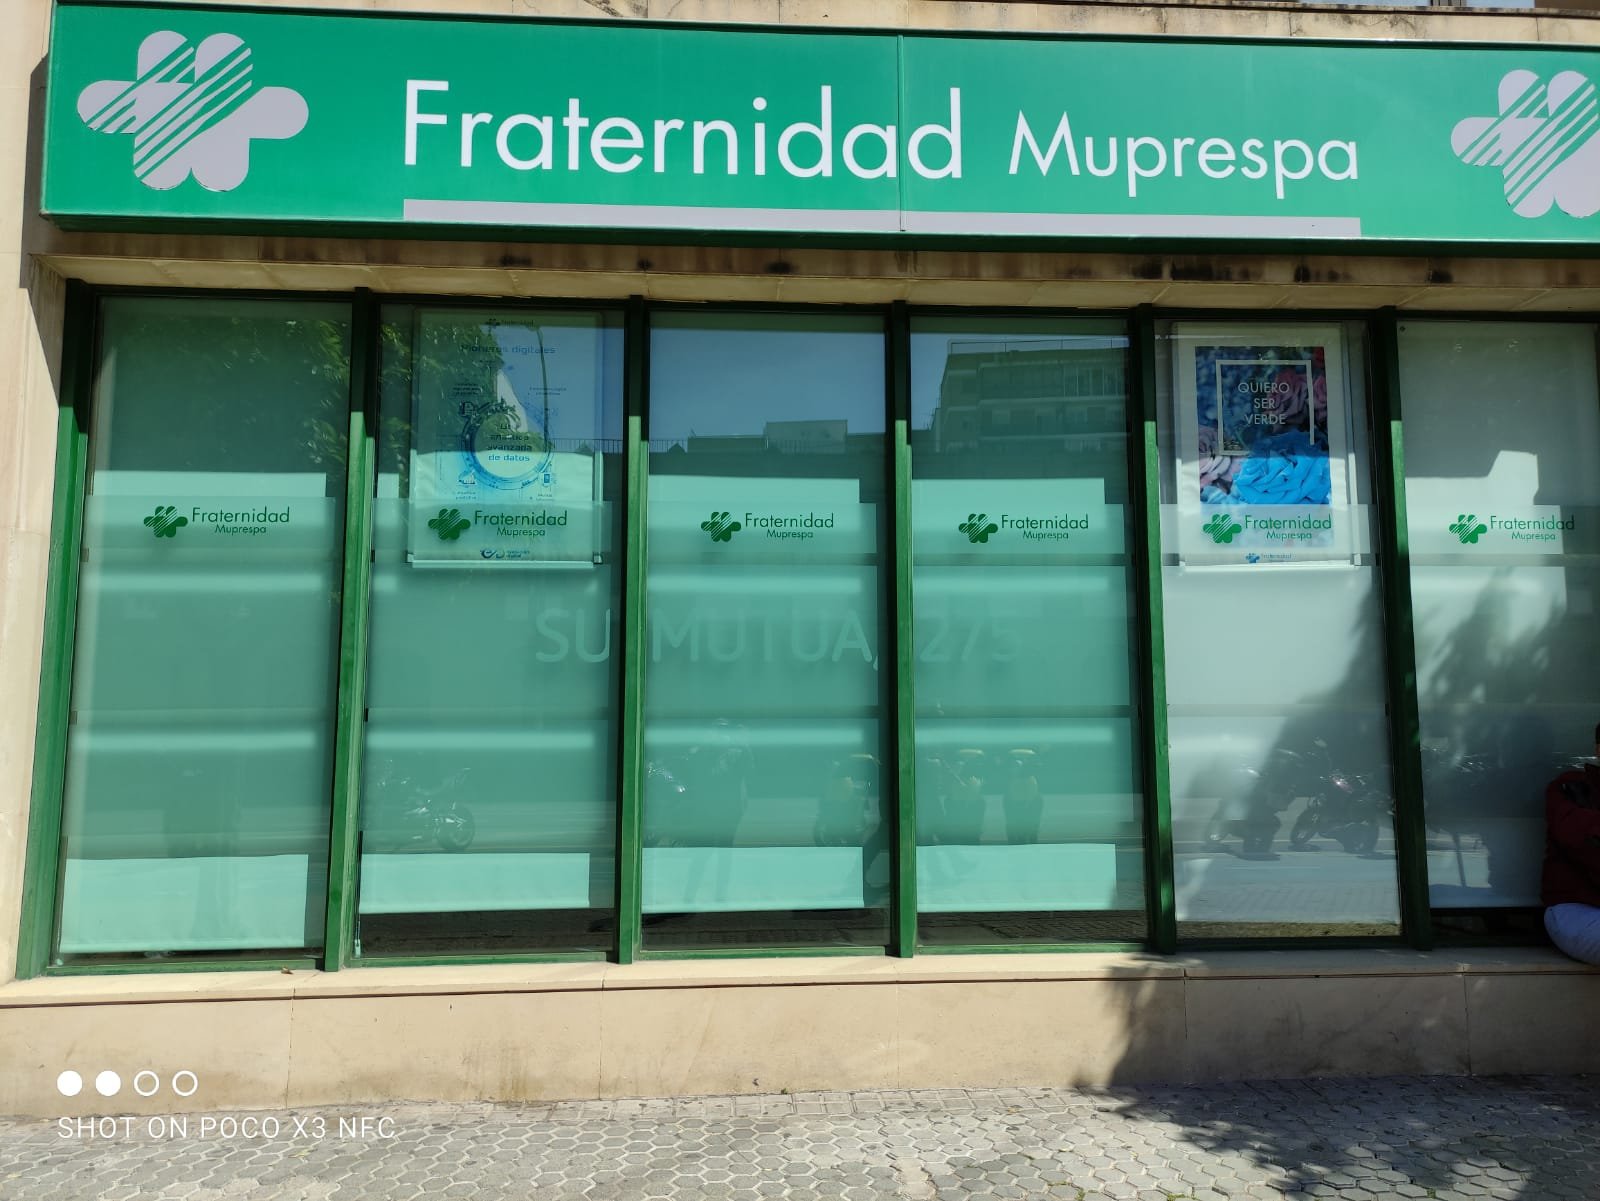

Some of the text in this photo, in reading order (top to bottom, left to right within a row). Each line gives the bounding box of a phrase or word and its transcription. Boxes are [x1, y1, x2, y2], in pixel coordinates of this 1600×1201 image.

[404, 79, 1360, 200] Fraternidad Muprespa
[1238, 382, 1290, 394] QUIERO
[1253, 398, 1276, 409] SER
[1244, 414, 1287, 425] VERDE
[488, 453, 530, 461] de datos
[192, 506, 290, 523] Fraternidad
[474, 510, 568, 526] Fraternidad
[745, 512, 834, 528] Fraternidad
[1001, 513, 1089, 529] Fraternidad
[1244, 514, 1332, 530] Fraternidad
[1490, 514, 1575, 530] Fraternidad
[214, 524, 267, 536] Muprespa
[496, 527, 546, 537] Muprespa
[766, 529, 814, 541] Muprespa
[1022, 531, 1069, 541] Muprespa
[1266, 531, 1313, 541] Muprespa
[1511, 532, 1556, 543] Muprespa
